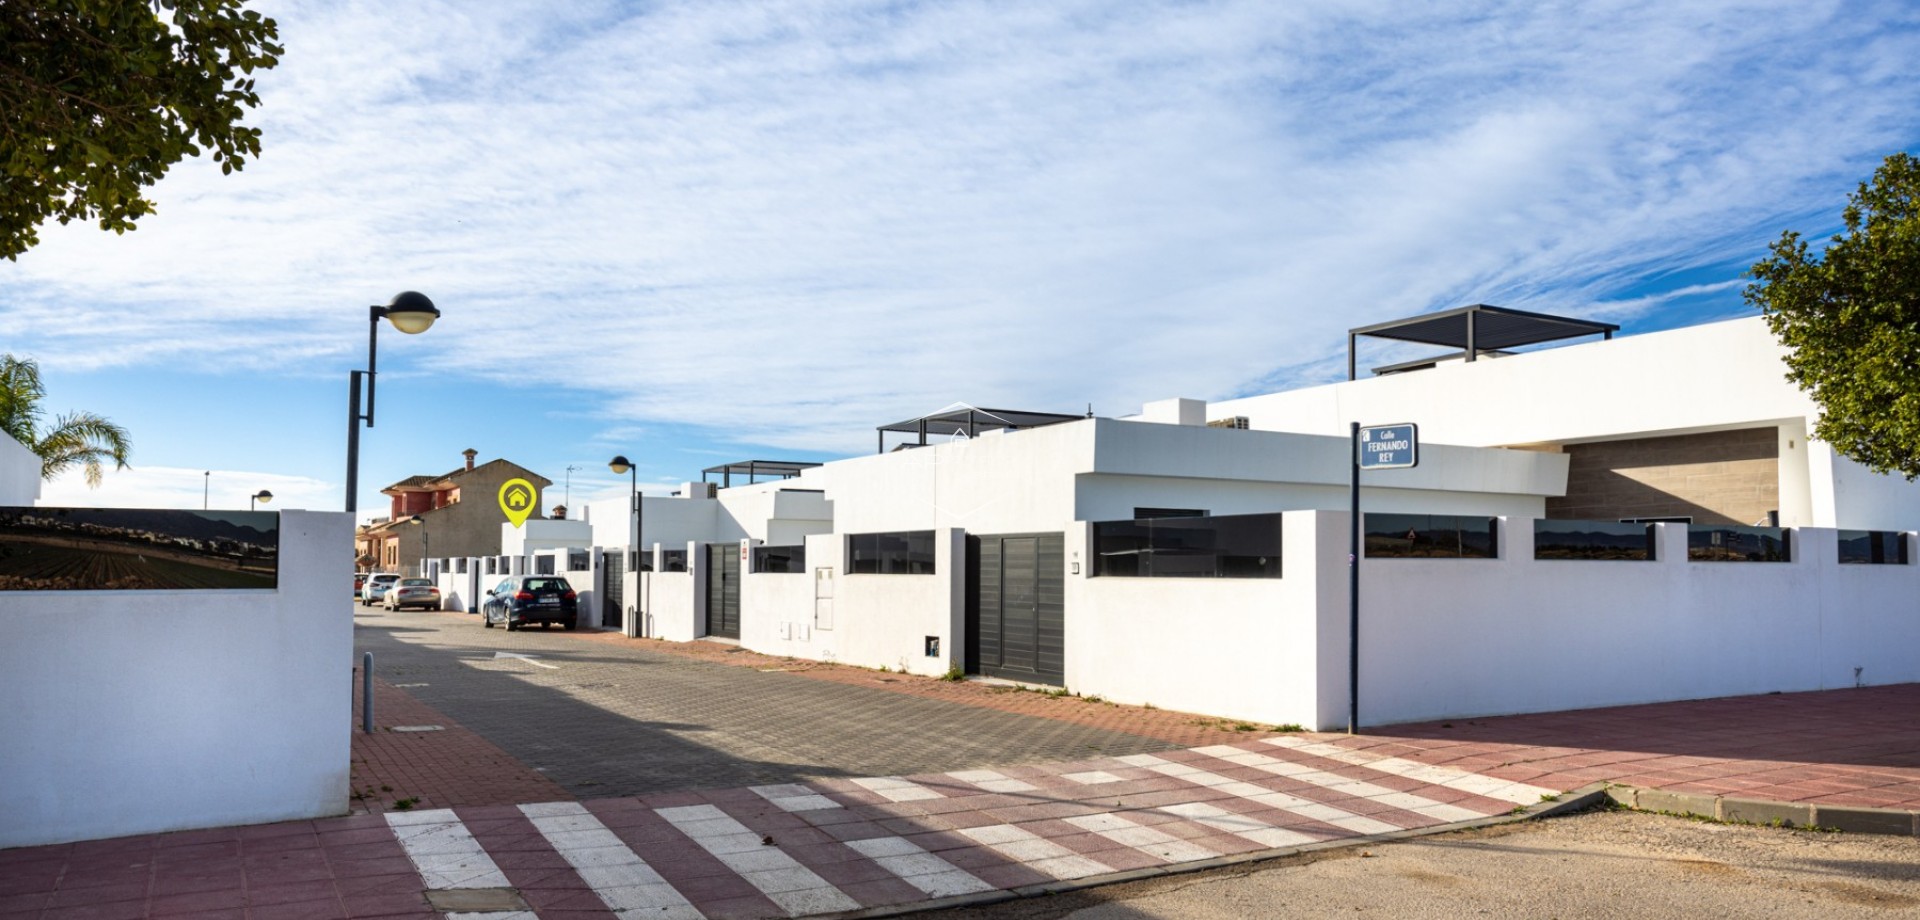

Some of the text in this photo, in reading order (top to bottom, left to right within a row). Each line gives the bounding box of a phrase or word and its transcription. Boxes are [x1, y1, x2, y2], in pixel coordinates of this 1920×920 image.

[1380, 430, 1394, 440] Calle
[1368, 440, 1408, 452] FERNANDO
[1379, 452, 1393, 462] REY
